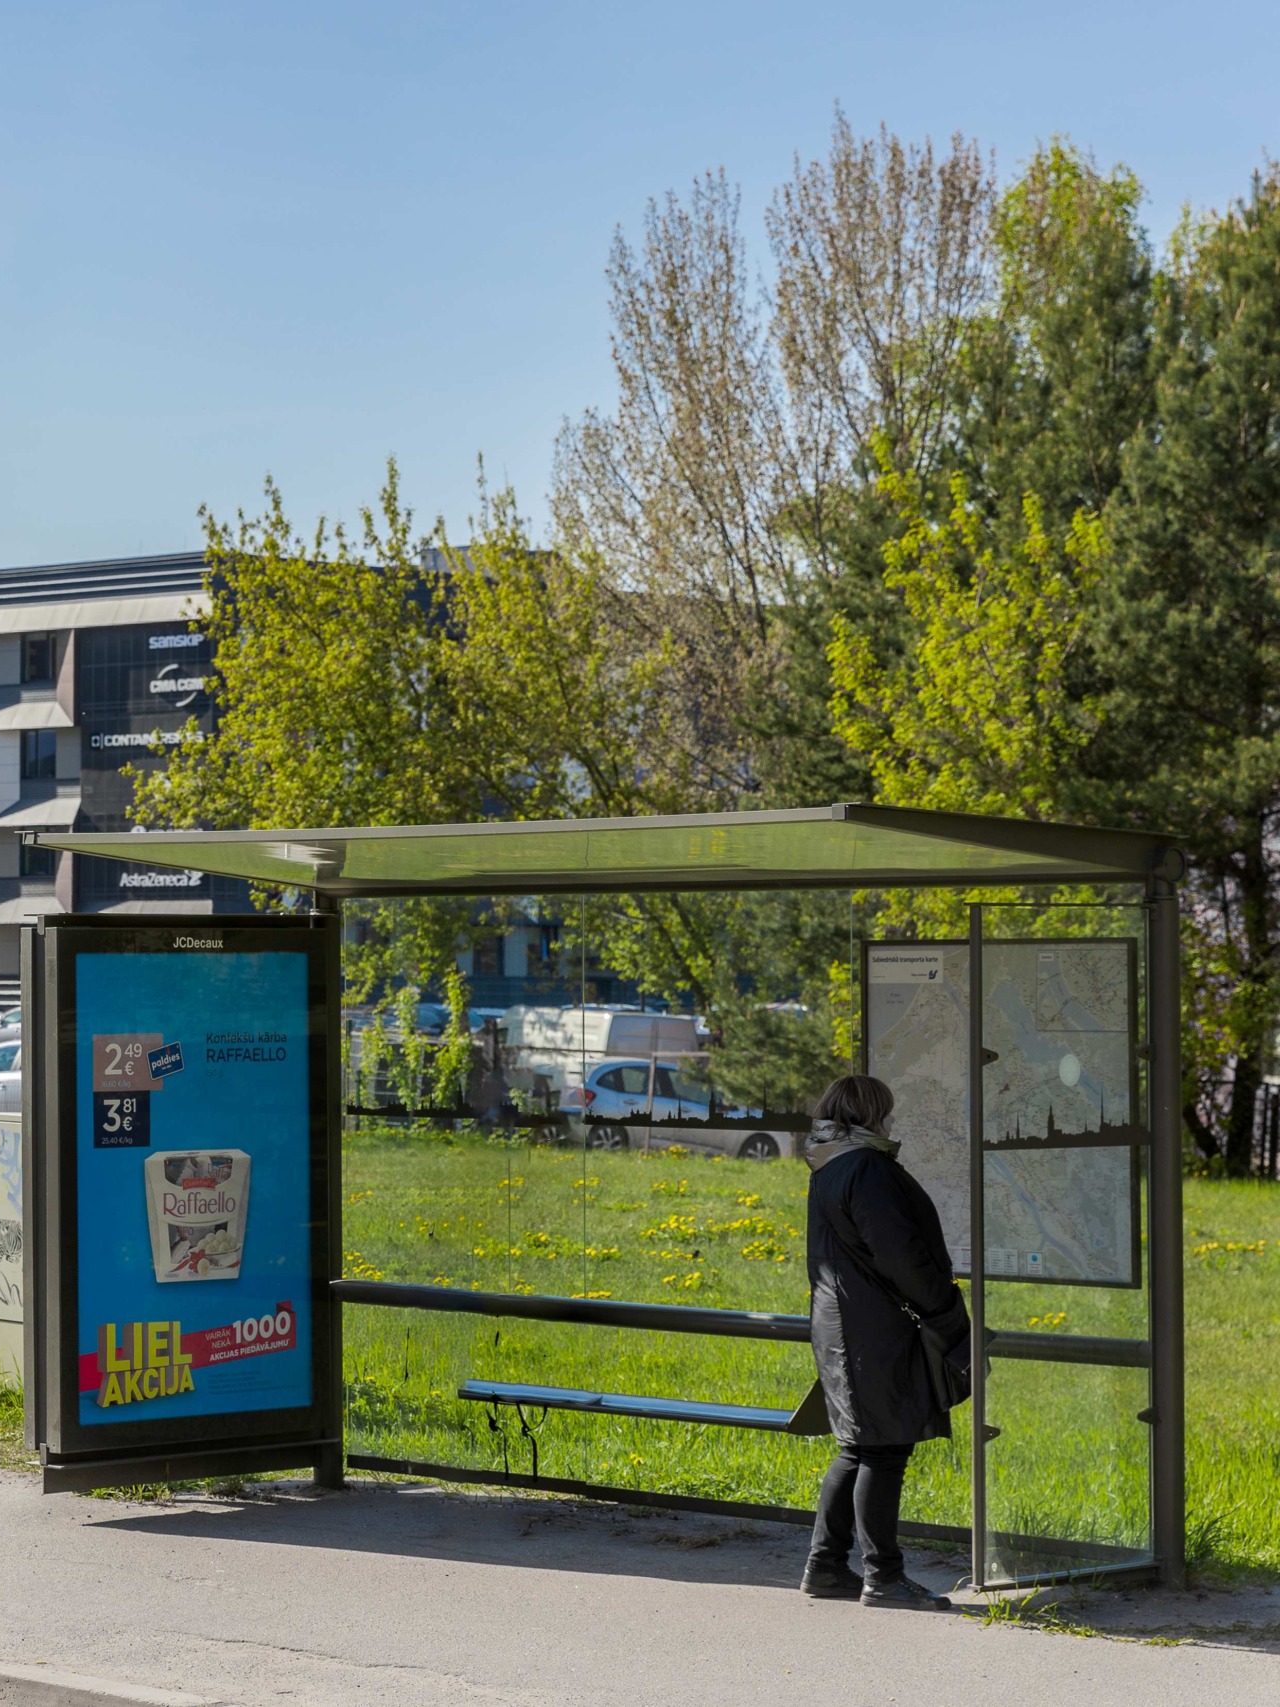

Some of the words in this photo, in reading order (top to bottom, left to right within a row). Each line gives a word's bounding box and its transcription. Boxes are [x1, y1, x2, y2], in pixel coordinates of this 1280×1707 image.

[150, 679, 177, 693] CMA
[119, 872, 188, 888] AstraZeneca
[173, 936, 224, 949] JCDecaux
[206, 1032, 255, 1044] Konfekšu
[258, 1031, 287, 1043] kārba
[206, 1047, 287, 1063] RAFFAELLO
[163, 1191, 236, 1218] Raffaello
[205, 1328, 231, 1341] VAIRĀK
[232, 1311, 291, 1344] 1000
[102, 1321, 193, 1373] LIEL
[209, 1349, 239, 1362] AKCIJAS
[100, 1365, 195, 1408] AKCIJA
